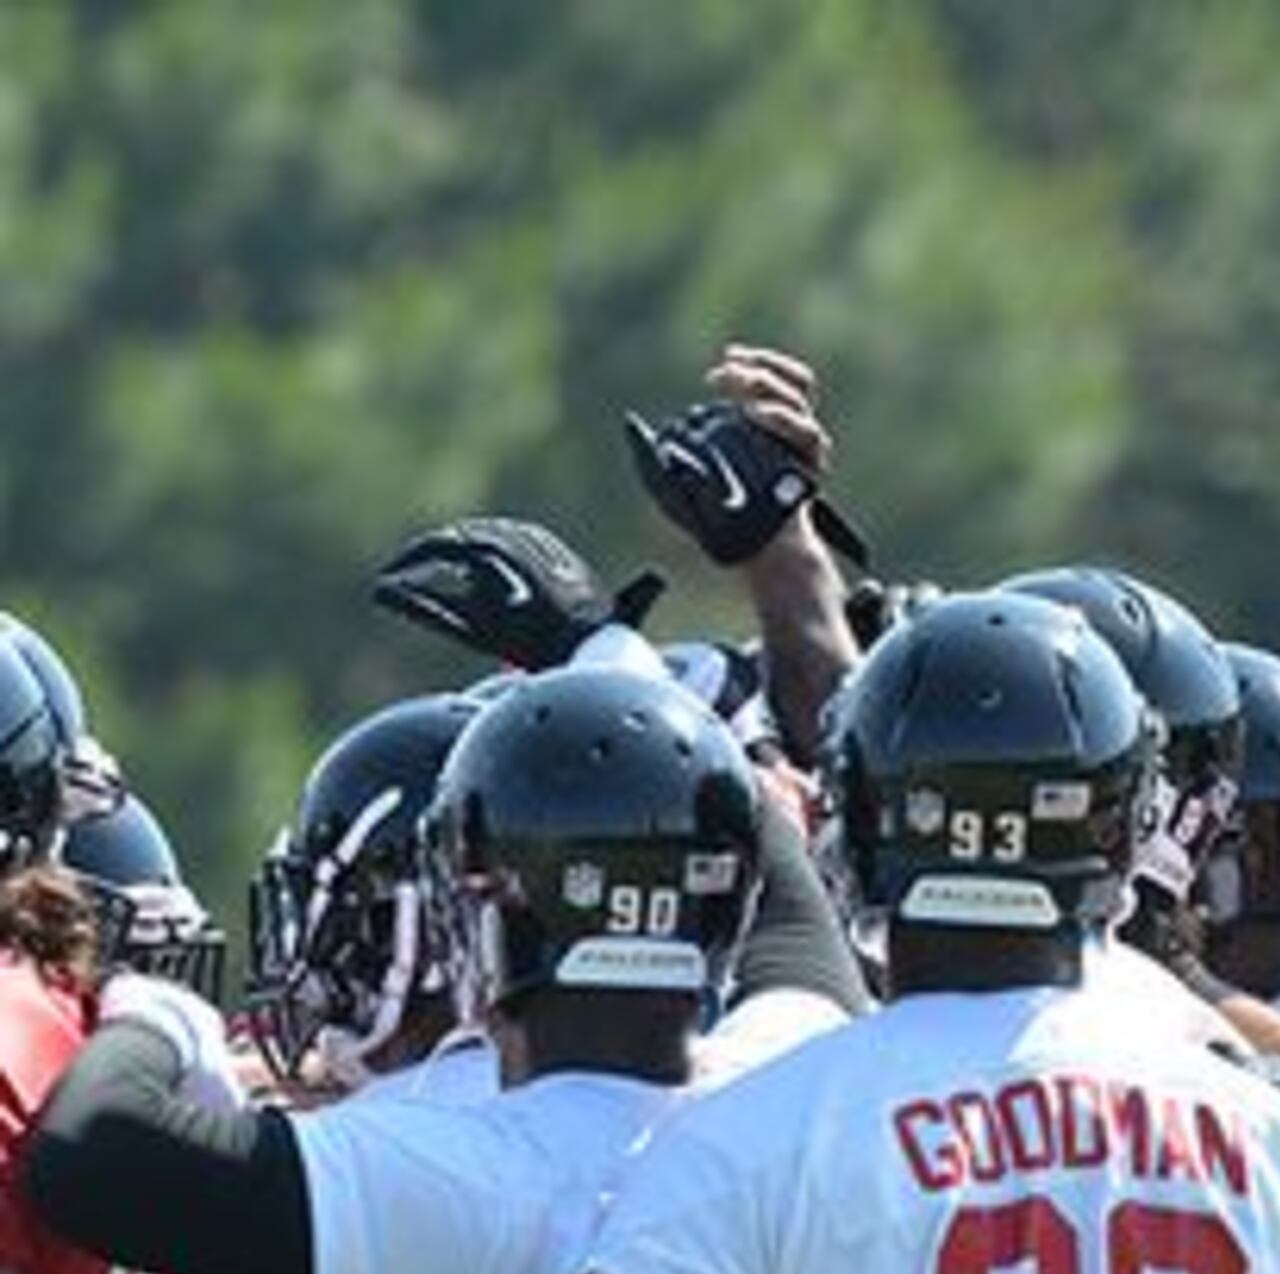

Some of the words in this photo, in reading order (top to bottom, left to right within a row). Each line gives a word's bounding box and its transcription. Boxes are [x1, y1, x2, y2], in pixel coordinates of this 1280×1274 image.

[950, 811, 1028, 864] 93
[607, 884, 680, 934] 90
[893, 1073, 1247, 1195] GOODMAN
